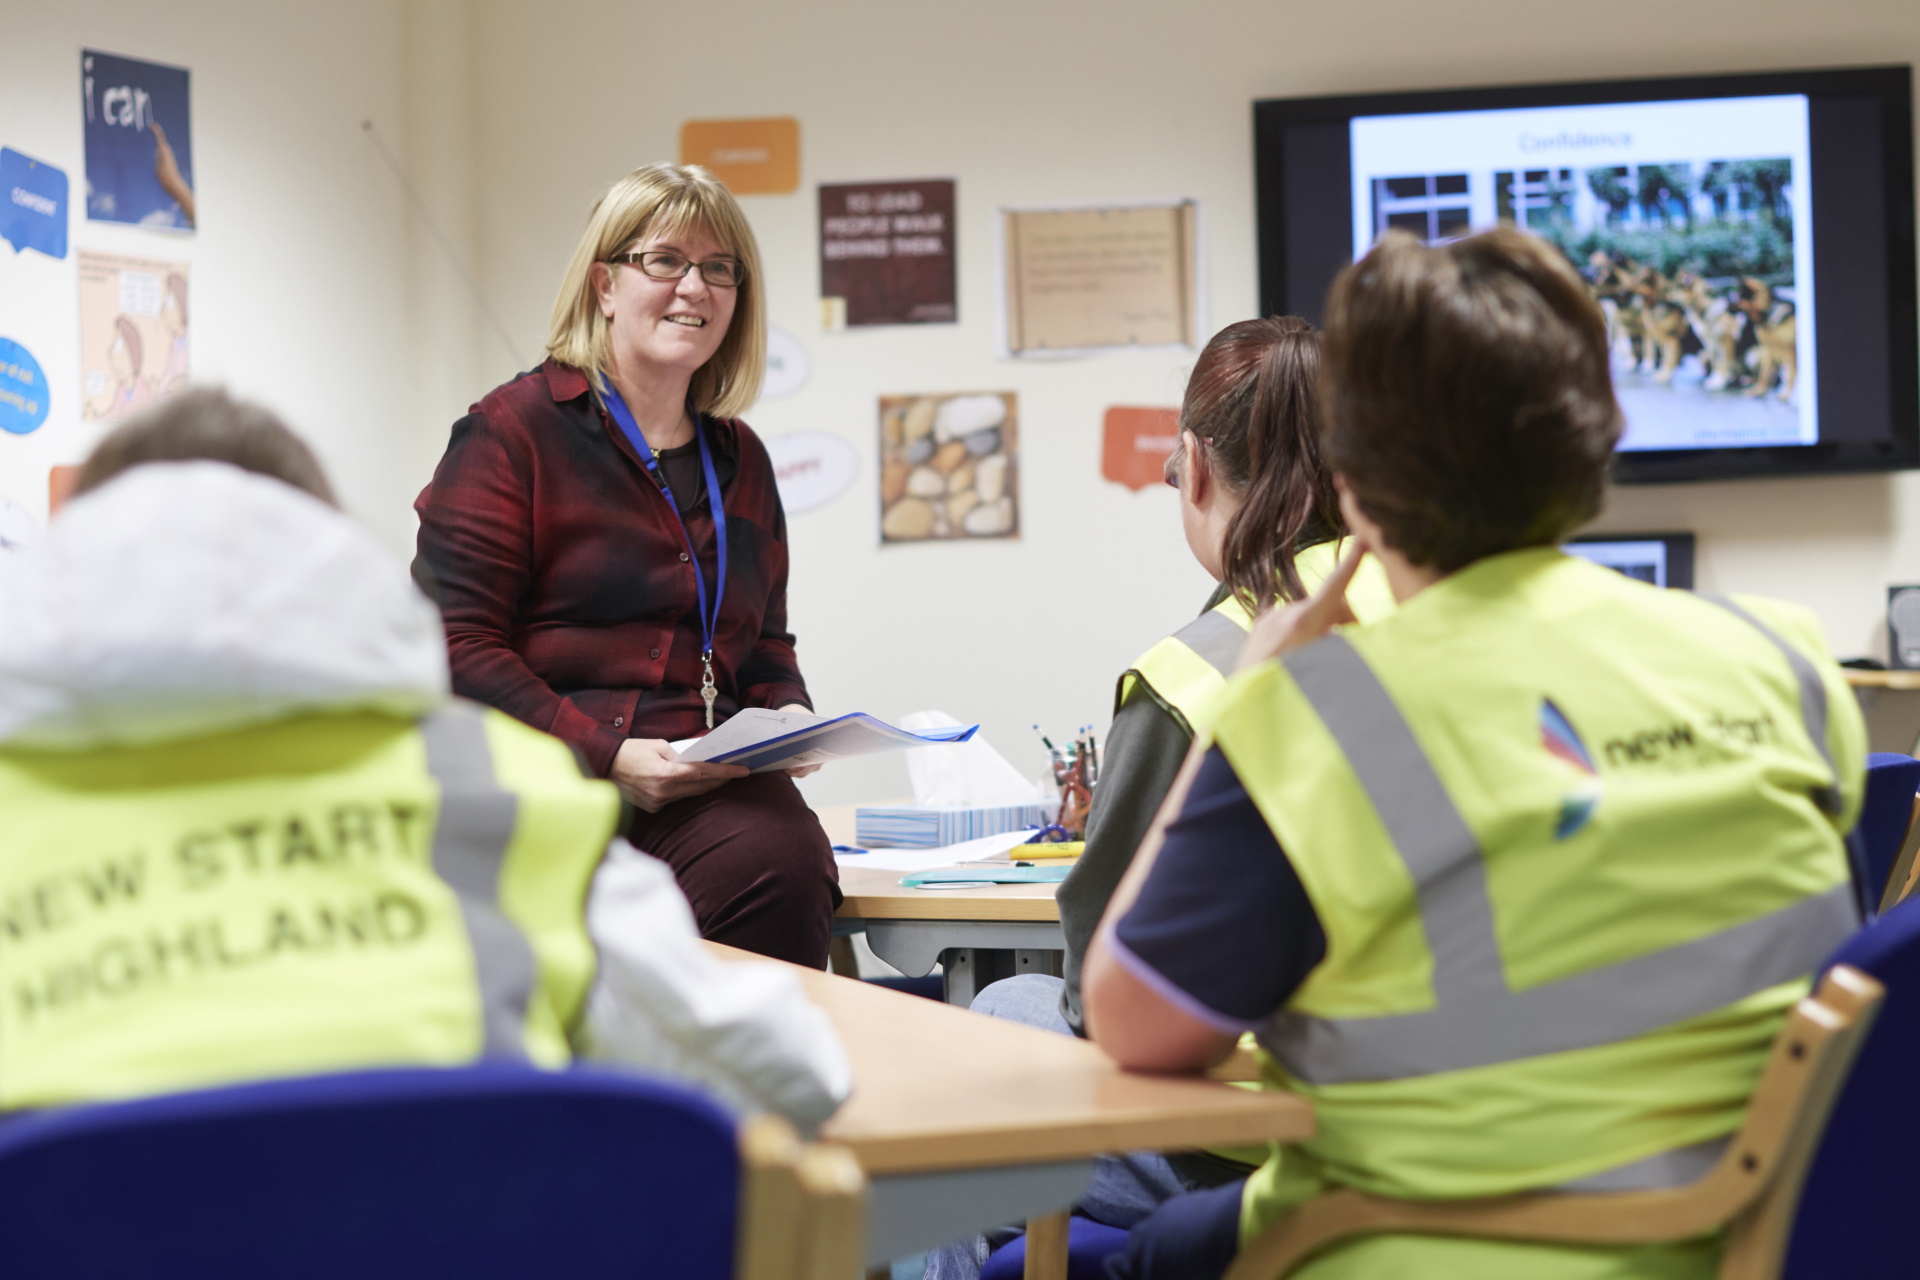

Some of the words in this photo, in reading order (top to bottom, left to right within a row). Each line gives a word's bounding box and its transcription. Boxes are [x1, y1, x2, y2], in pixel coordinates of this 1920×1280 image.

[103, 85, 154, 132] can
[1518, 130, 1634, 154] Confidence
[846, 192, 872, 214] TO
[874, 190, 923, 213] LEAD
[825, 216, 890, 236] PEOPLE
[893, 213, 944, 233] WALK
[825, 238, 889, 260] BEHIND
[775, 457, 822, 480] APPY
[1603, 722, 1694, 768] new
[174, 798, 422, 892] START
[14, 892, 430, 1028] HIGHLAND
